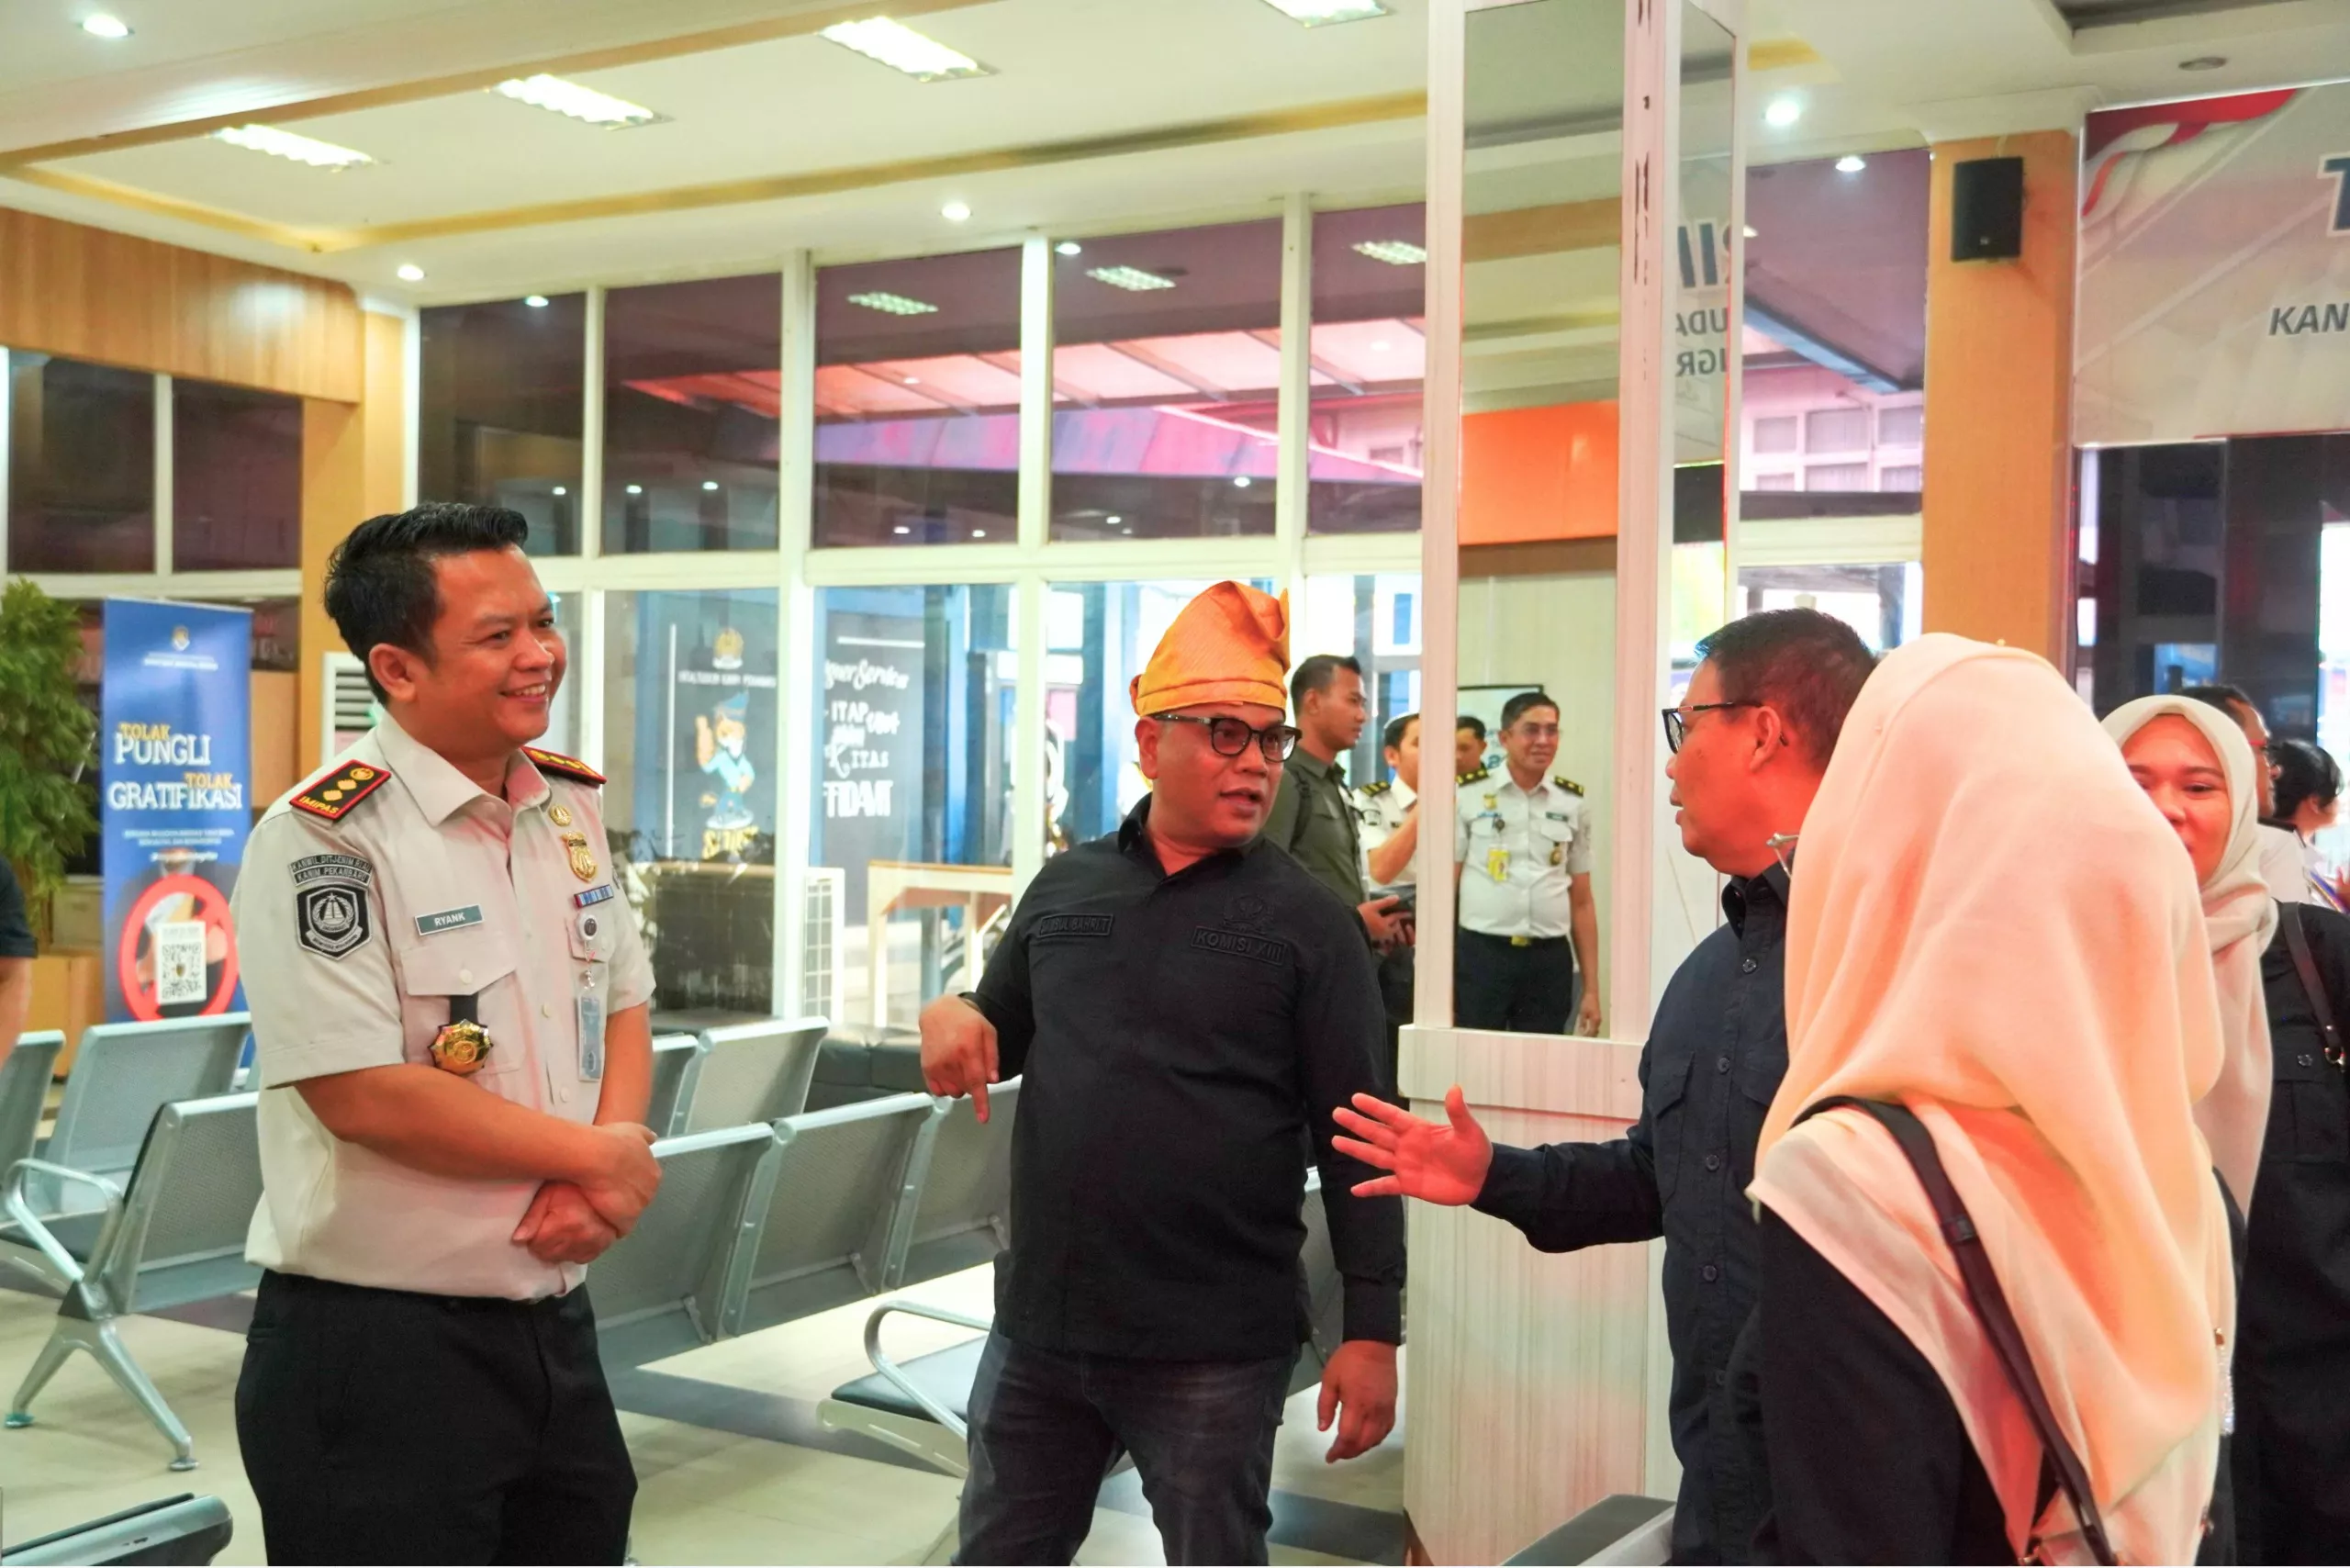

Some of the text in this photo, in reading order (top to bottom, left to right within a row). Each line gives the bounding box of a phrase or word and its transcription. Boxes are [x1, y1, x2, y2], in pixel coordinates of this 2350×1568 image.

[2268, 303, 2350, 336] KAN
[118, 722, 171, 741] TOLAK
[114, 732, 211, 766] PUNGLI
[185, 772, 233, 790] TOLAK
[107, 781, 243, 811] GRATIFIKASI
[297, 796, 340, 814] IMIPAS
[291, 856, 319, 871] KANWIL
[297, 867, 367, 881] KANIM PEKANBARU
[434, 912, 466, 926] RYANK
[1196, 930, 1251, 953] KOMISI
